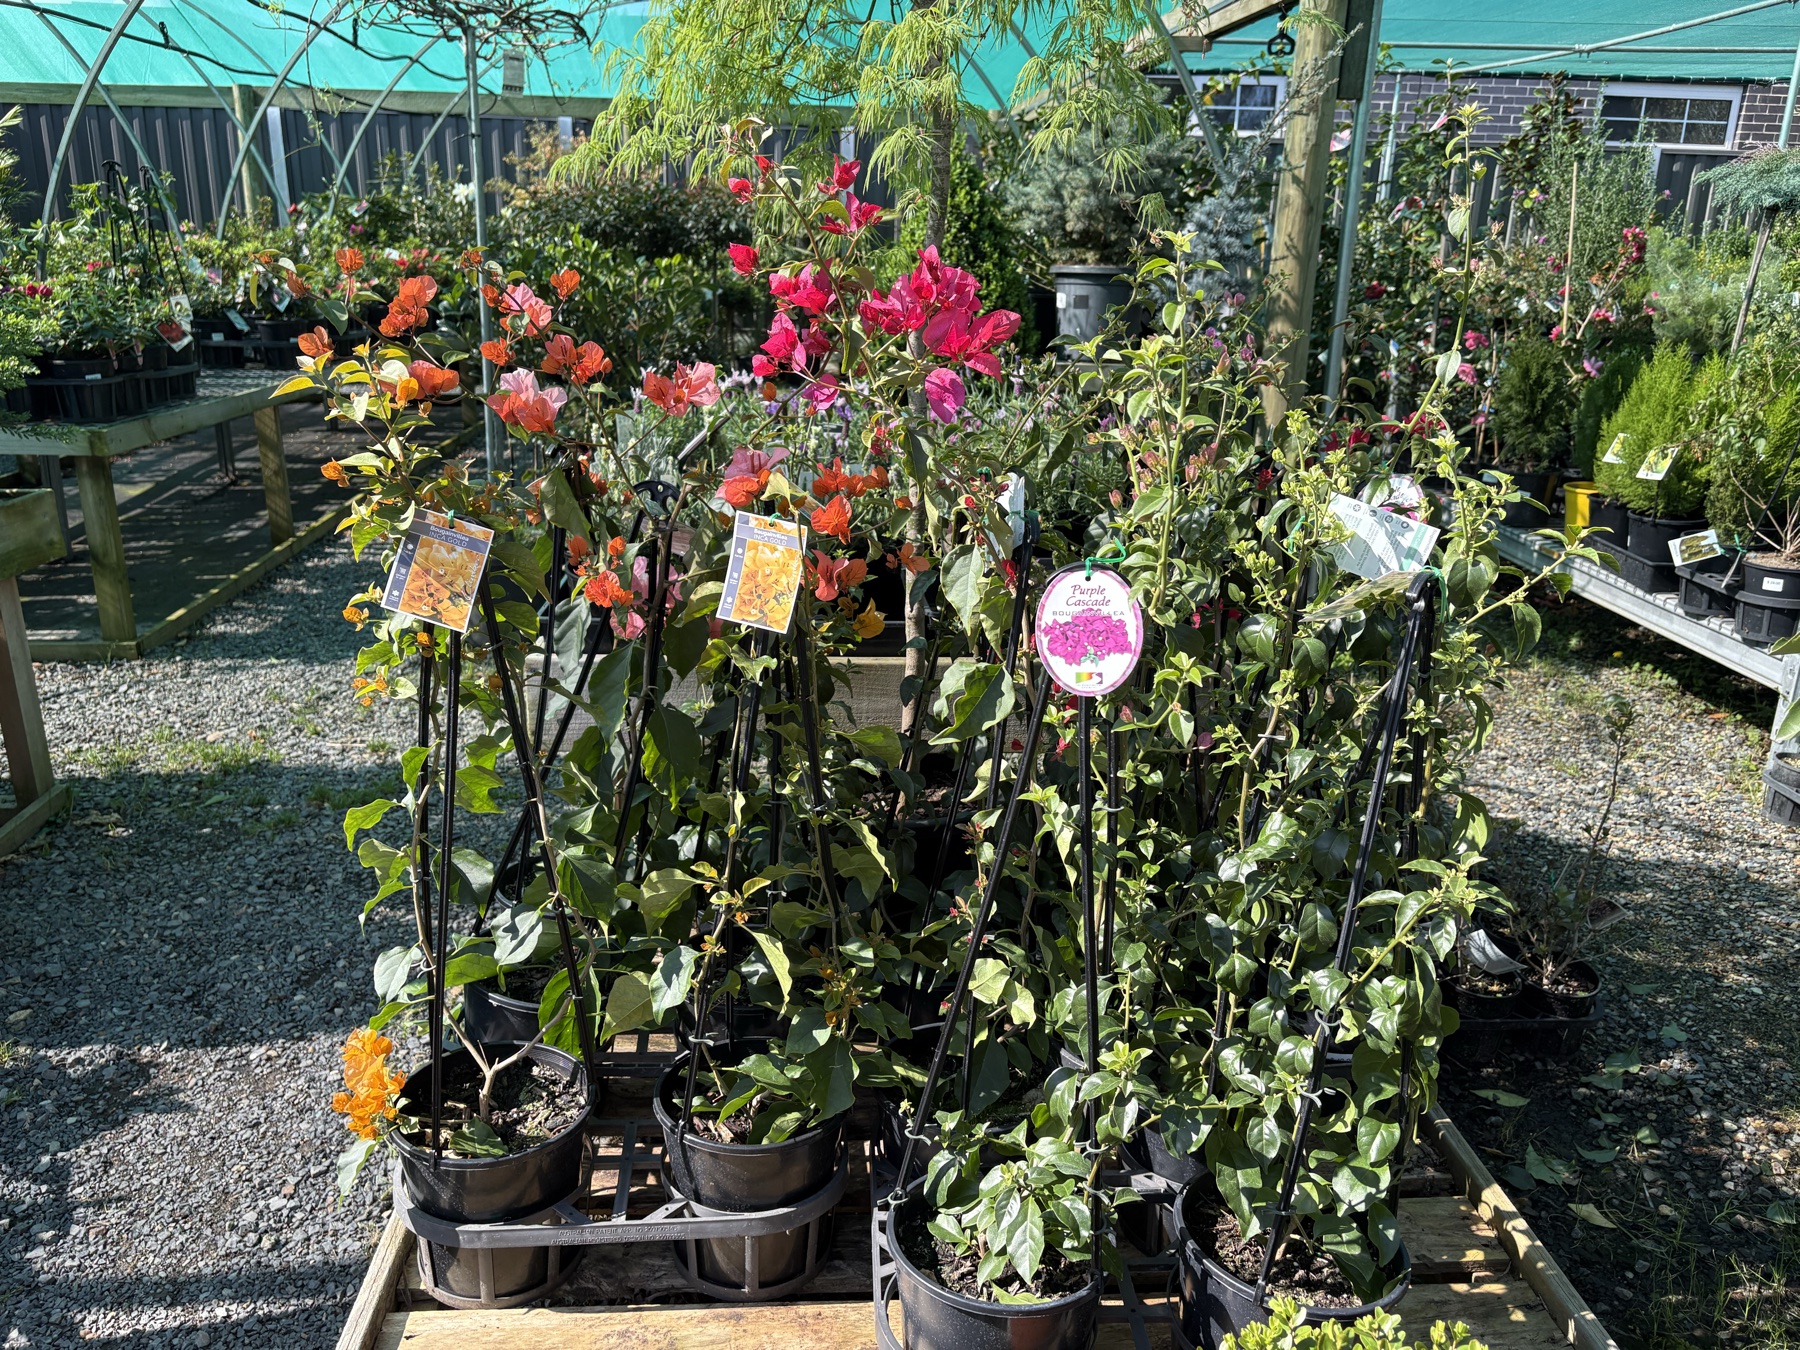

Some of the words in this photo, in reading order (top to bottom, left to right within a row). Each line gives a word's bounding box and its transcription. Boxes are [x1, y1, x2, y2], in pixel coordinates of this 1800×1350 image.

[428, 531, 446, 541] INCA
[447, 536, 468, 547] GOLD
[430, 525, 470, 542] Bougainvillea
[753, 533, 769, 542] INCA
[769, 537, 787, 546] GOLD
[1070, 584, 1106, 598] Purple
[1065, 595, 1111, 607] Cascade
